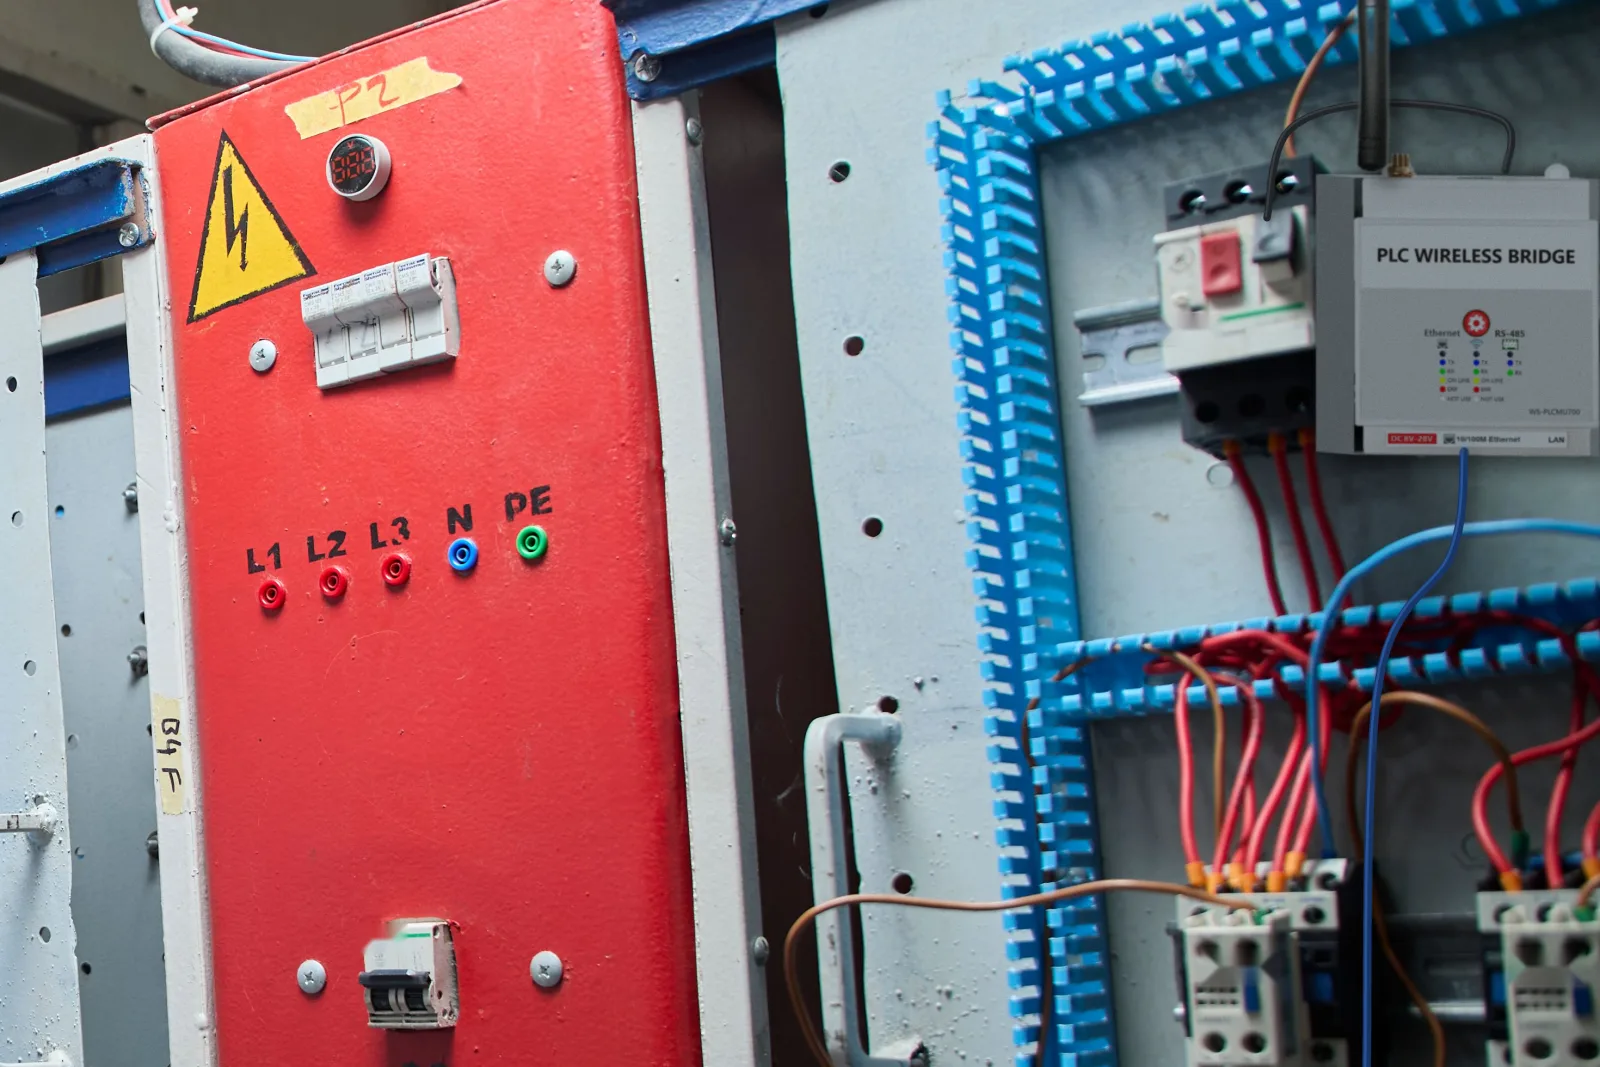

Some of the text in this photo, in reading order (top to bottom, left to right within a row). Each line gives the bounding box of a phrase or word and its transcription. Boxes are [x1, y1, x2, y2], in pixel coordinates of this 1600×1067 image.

[1377, 247, 1576, 264] PLC WIRELESS BRIDGE
[1424, 329, 1460, 337] Ethernet
[447, 503, 474, 534] N
[505, 485, 553, 522] PE
[306, 530, 347, 563] L2
[370, 516, 411, 550] L3
[246, 542, 282, 574] L1
[162, 767, 182, 793] F
